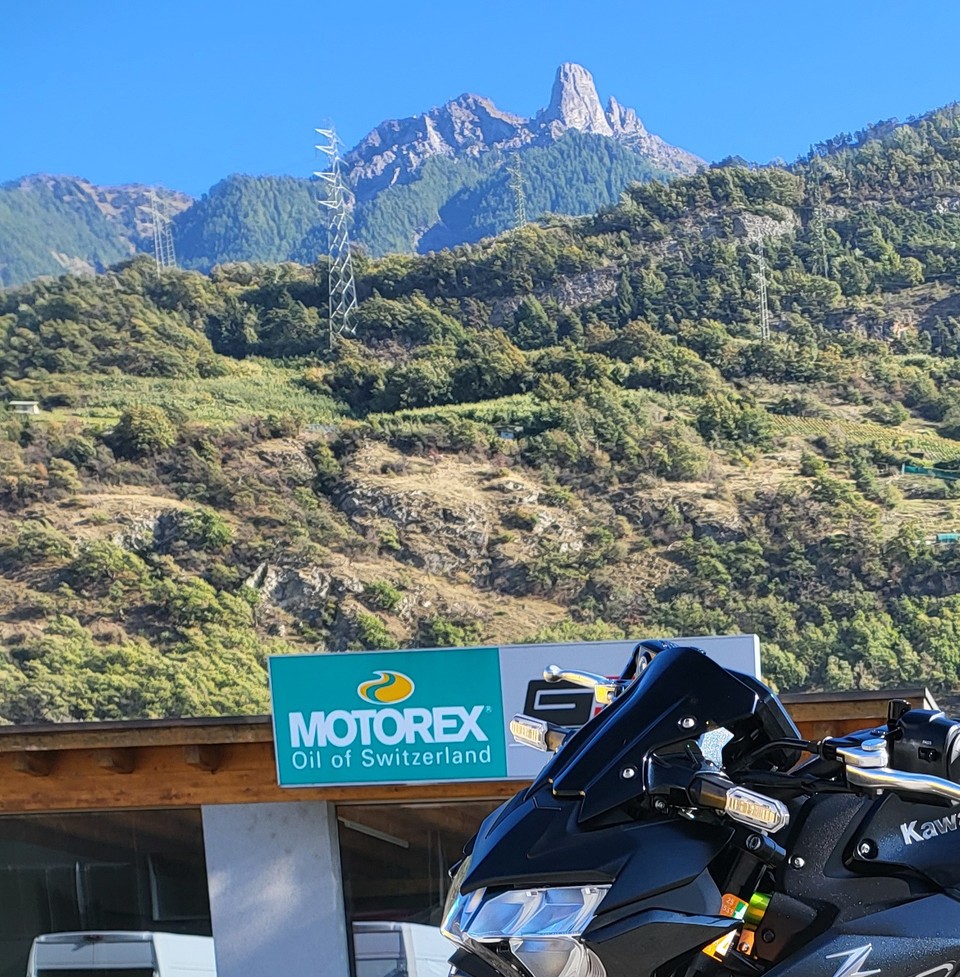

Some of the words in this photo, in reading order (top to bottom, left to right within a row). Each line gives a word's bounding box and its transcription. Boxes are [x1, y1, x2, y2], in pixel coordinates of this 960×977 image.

[288, 704, 489, 748] MOTOREX
[291, 750, 323, 770] Oil
[331, 750, 352, 769] of
[361, 746, 492, 767] Switzerland
